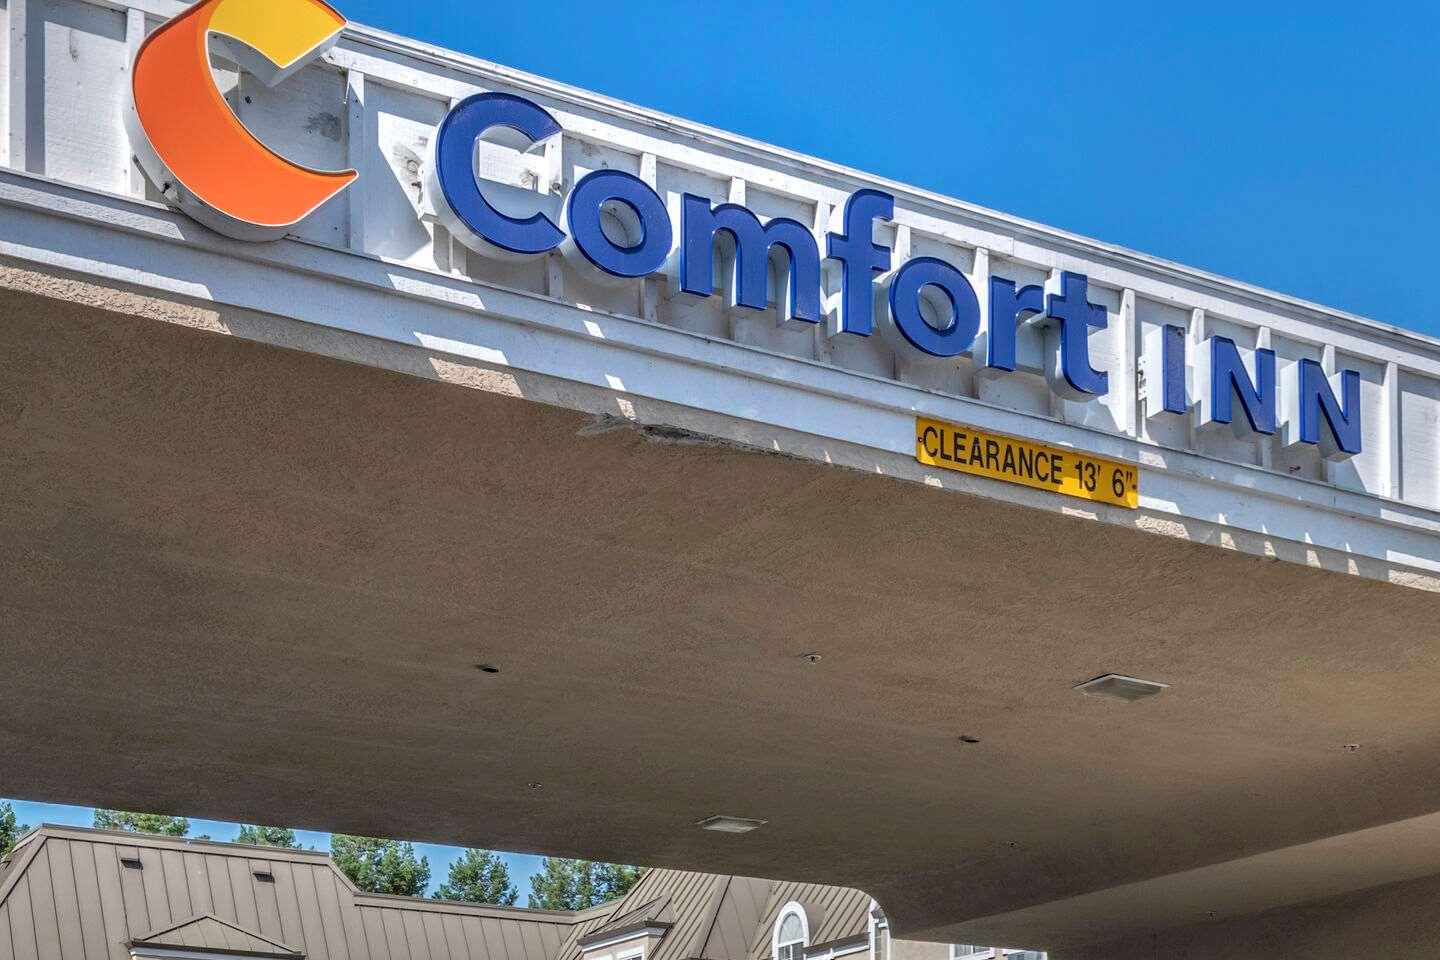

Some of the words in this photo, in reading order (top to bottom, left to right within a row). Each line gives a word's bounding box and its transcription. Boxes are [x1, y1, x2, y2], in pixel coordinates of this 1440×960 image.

[435, 91, 1109, 397] Comfort
[1161, 323, 1361, 453] INN
[923, 426, 1064, 484] CLEARANCE
[1075, 460, 1101, 492] 13'
